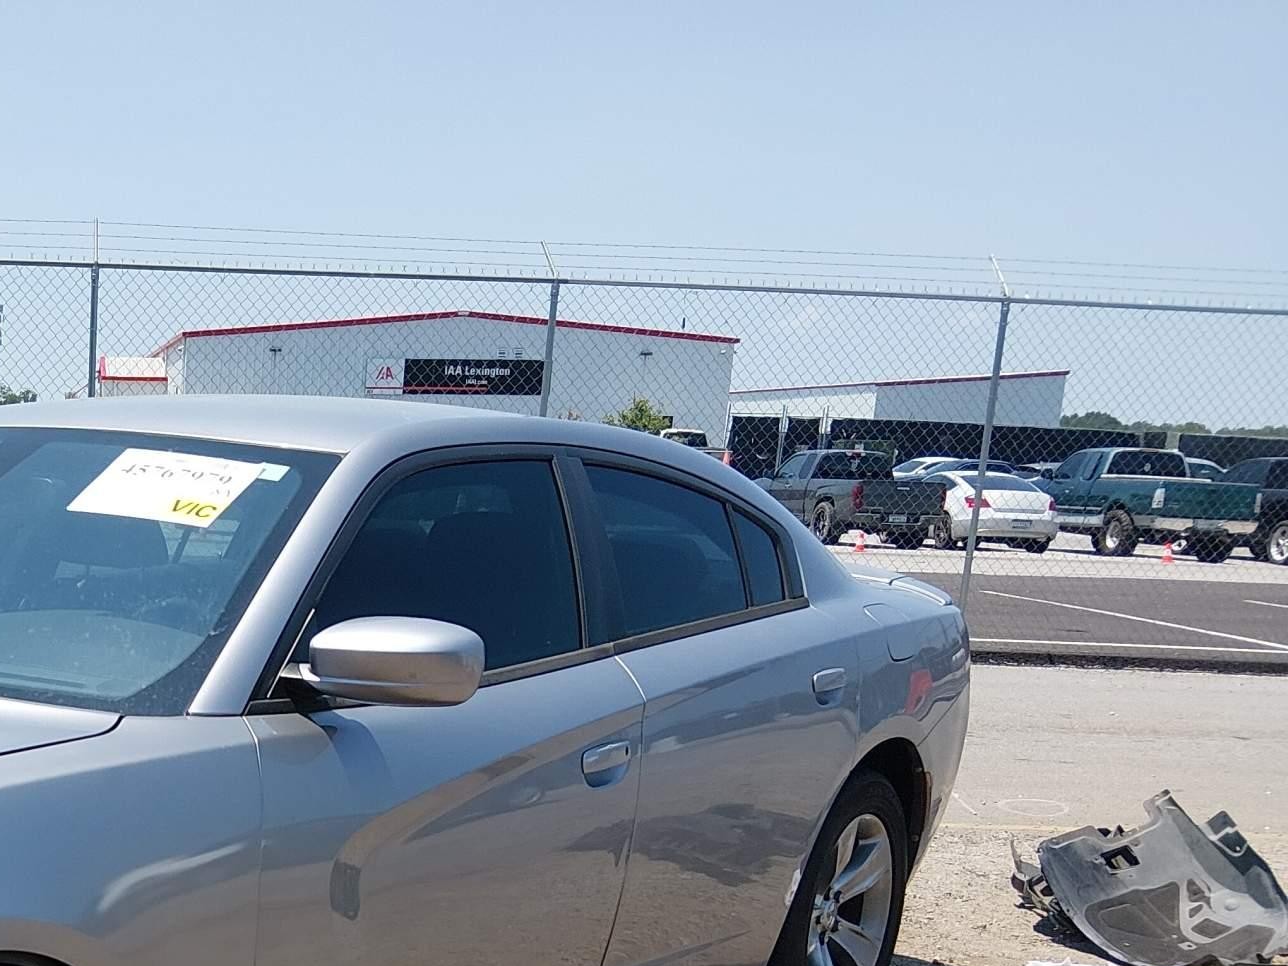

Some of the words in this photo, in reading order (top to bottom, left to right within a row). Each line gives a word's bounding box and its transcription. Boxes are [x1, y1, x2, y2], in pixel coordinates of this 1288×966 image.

[444, 365, 462, 376] IAA
[465, 366, 511, 378] Lexington
[172, 499, 218, 518] VIC
